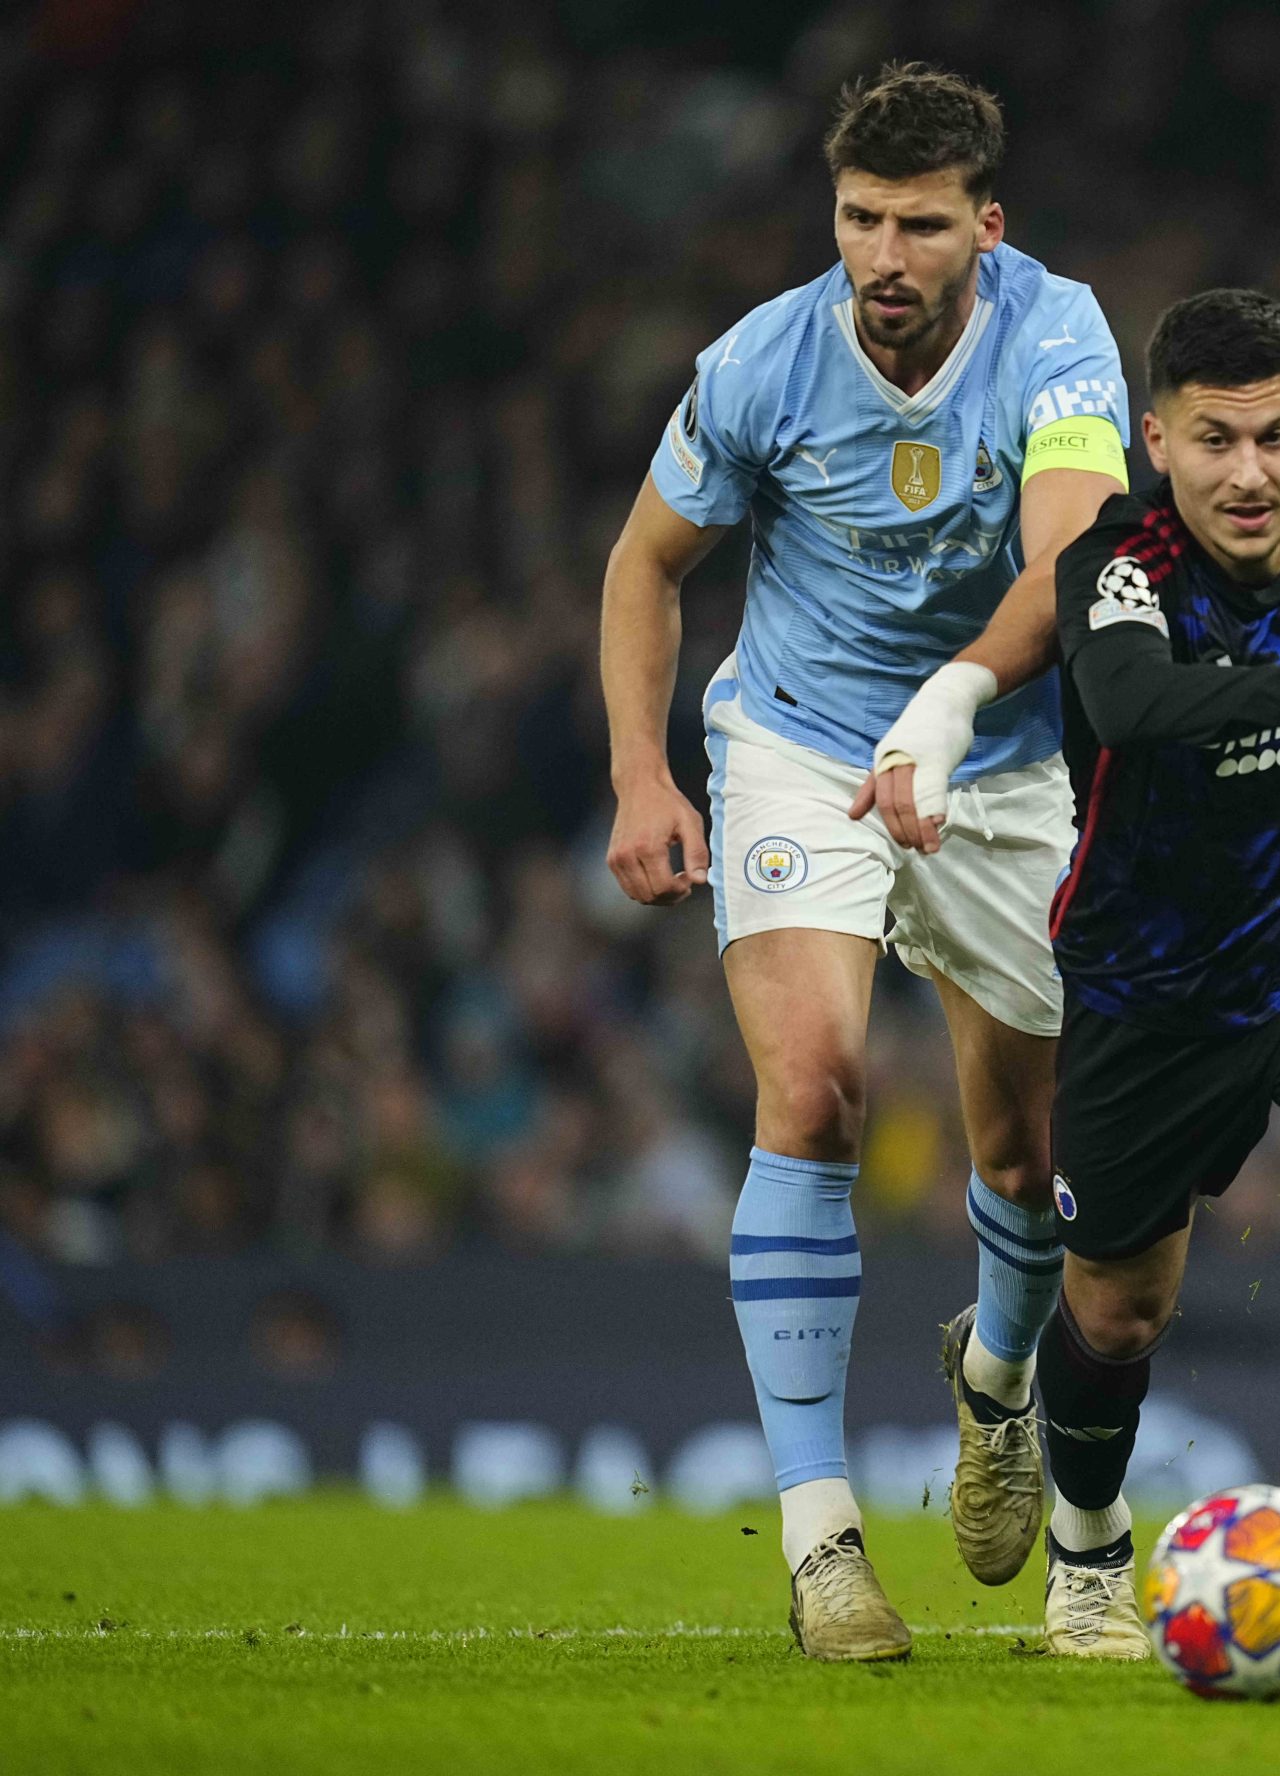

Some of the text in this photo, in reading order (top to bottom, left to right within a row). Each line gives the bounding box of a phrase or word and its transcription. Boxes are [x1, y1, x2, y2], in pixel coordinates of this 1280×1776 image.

[904, 484, 926, 496] FIFA
[976, 480, 995, 490] CITY
[849, 553, 967, 584] AIRWAY
[751, 841, 801, 860] MANCHESTER
[774, 1327, 841, 1340] CITY
